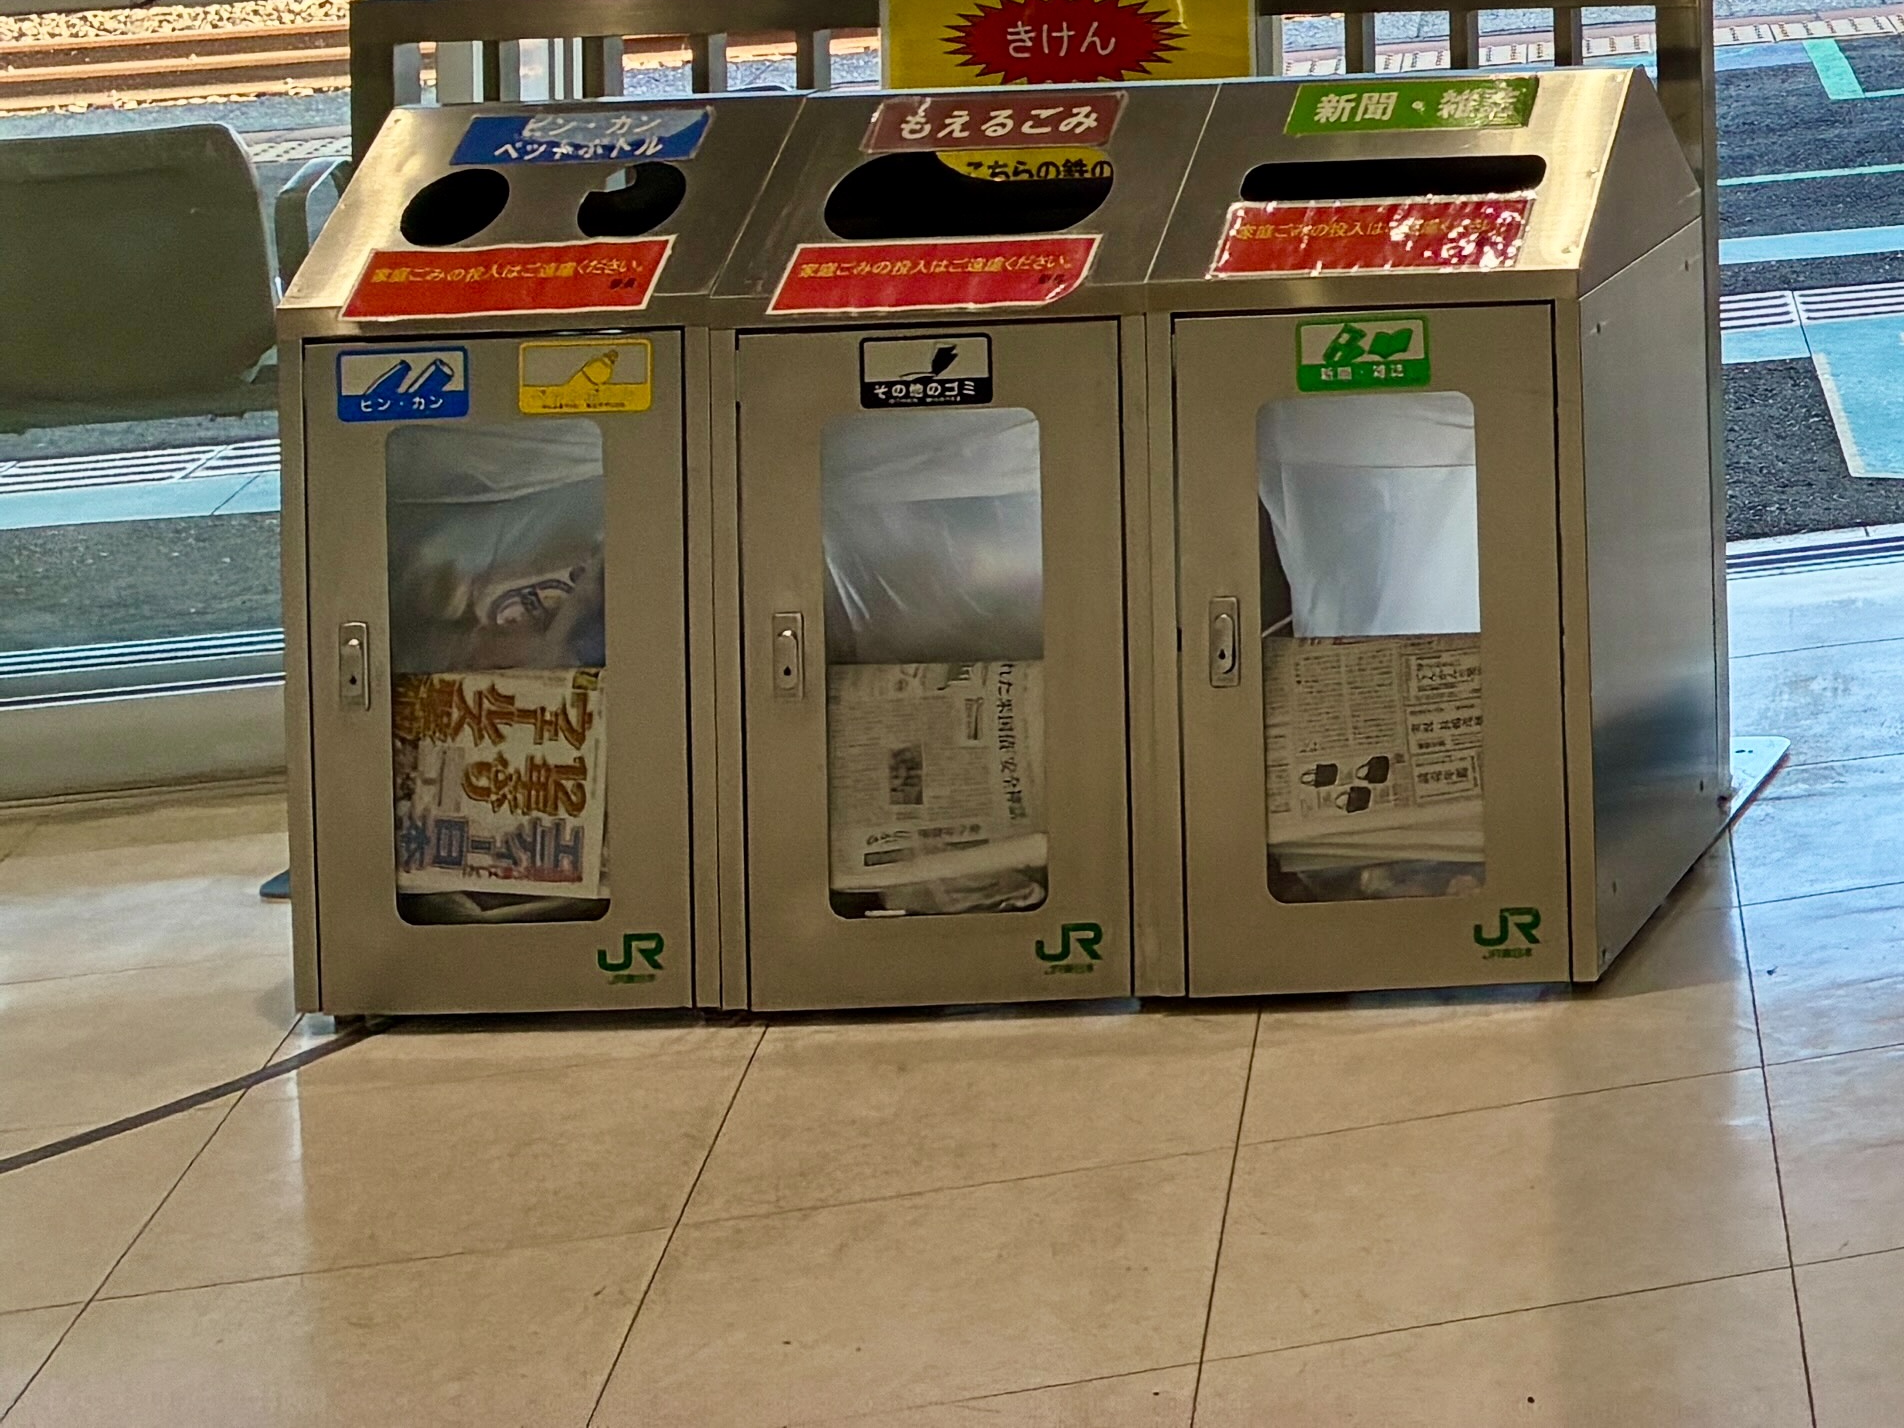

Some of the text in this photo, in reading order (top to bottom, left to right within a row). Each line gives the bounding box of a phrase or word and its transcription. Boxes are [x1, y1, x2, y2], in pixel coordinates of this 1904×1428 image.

[1006, 21, 1116, 58] きけん
[901, 106, 1099, 140] もえるごみ
[873, 381, 976, 399] その他のゴミ
[1035, 922, 1103, 962] JR
[1473, 907, 1542, 947] JR
[597, 932, 665, 972] JR
